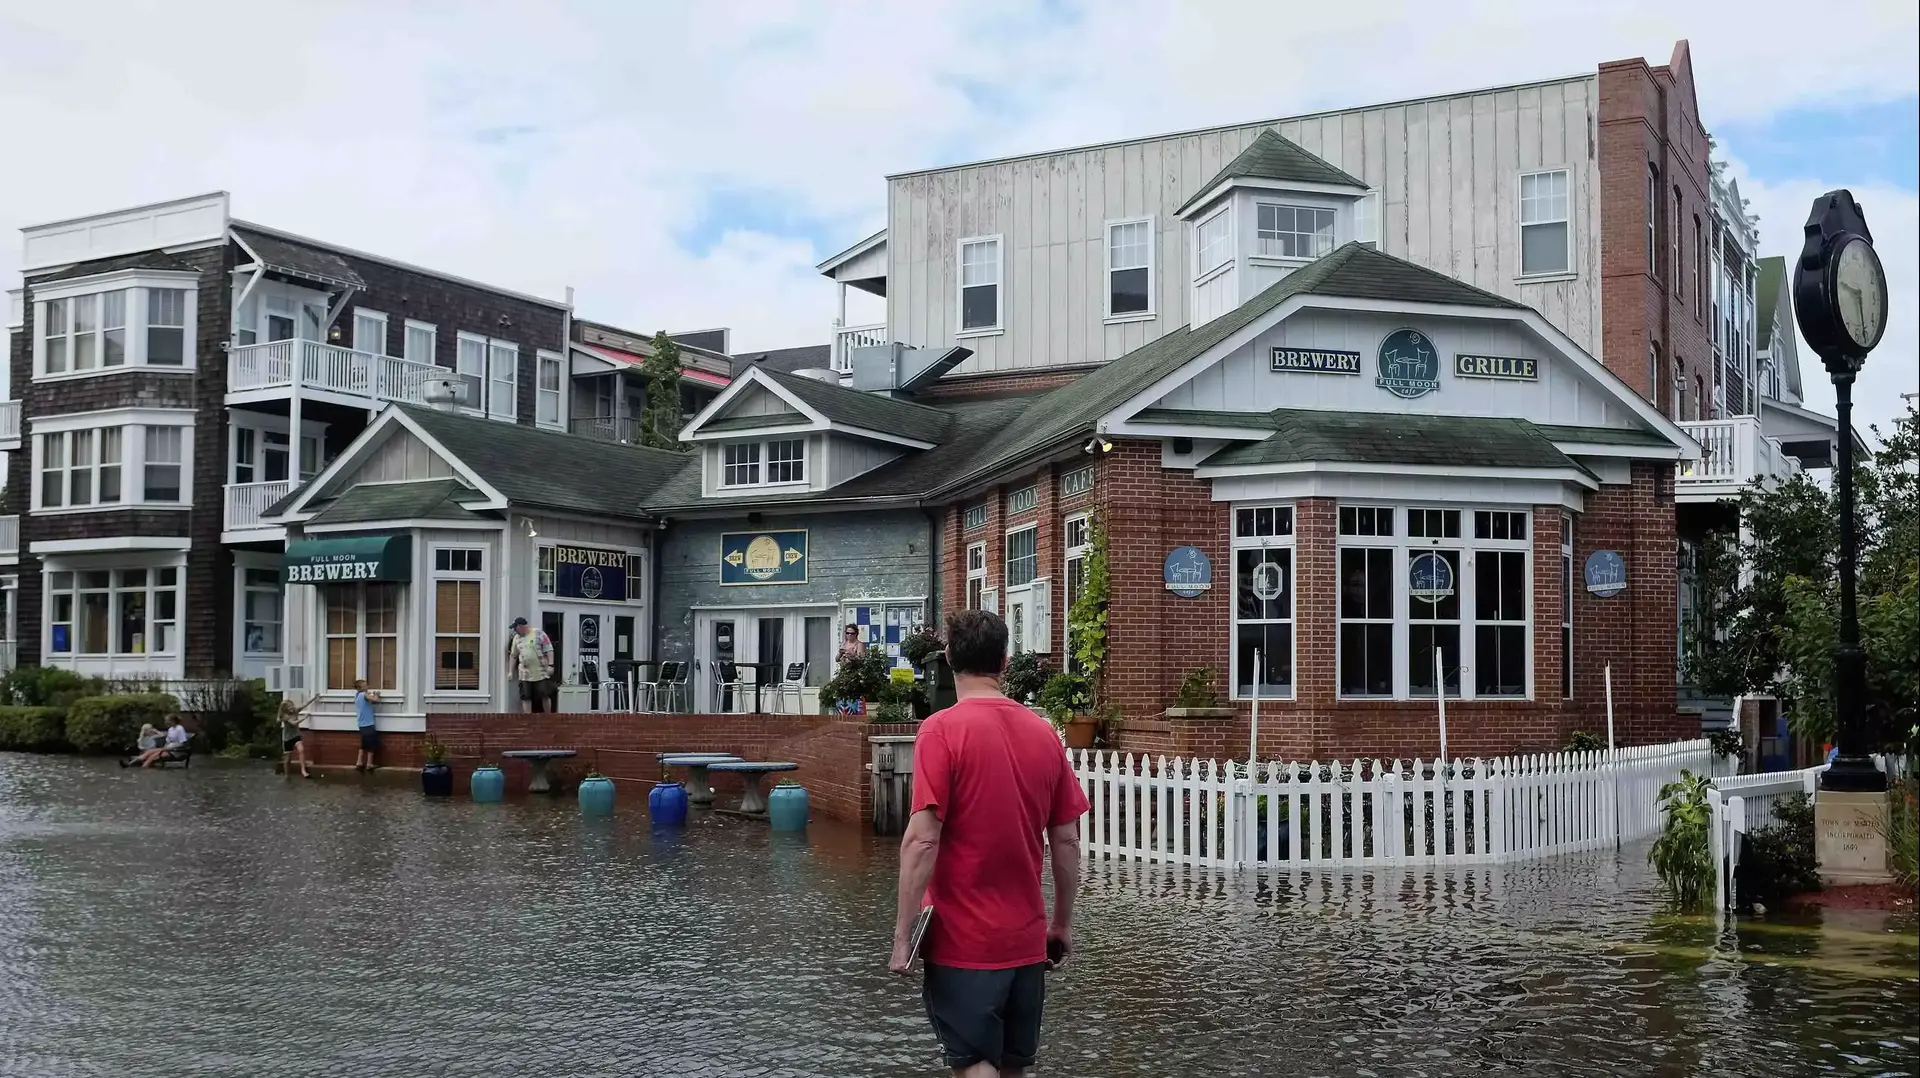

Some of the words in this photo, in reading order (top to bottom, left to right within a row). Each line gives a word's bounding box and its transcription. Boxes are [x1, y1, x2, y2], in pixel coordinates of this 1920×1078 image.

[1273, 350, 1360, 371] BREWERY
[1459, 356, 1535, 377] GRILLE
[1379, 379, 1404, 387] FULL
[1408, 381, 1438, 389] MOON
[966, 506, 988, 528] FULL
[1009, 487, 1039, 513] MOON
[310, 555, 330, 563] FULL
[333, 554, 356, 562] MOON
[557, 547, 626, 568] BREWERY
[287, 561, 380, 582] BREWERY
